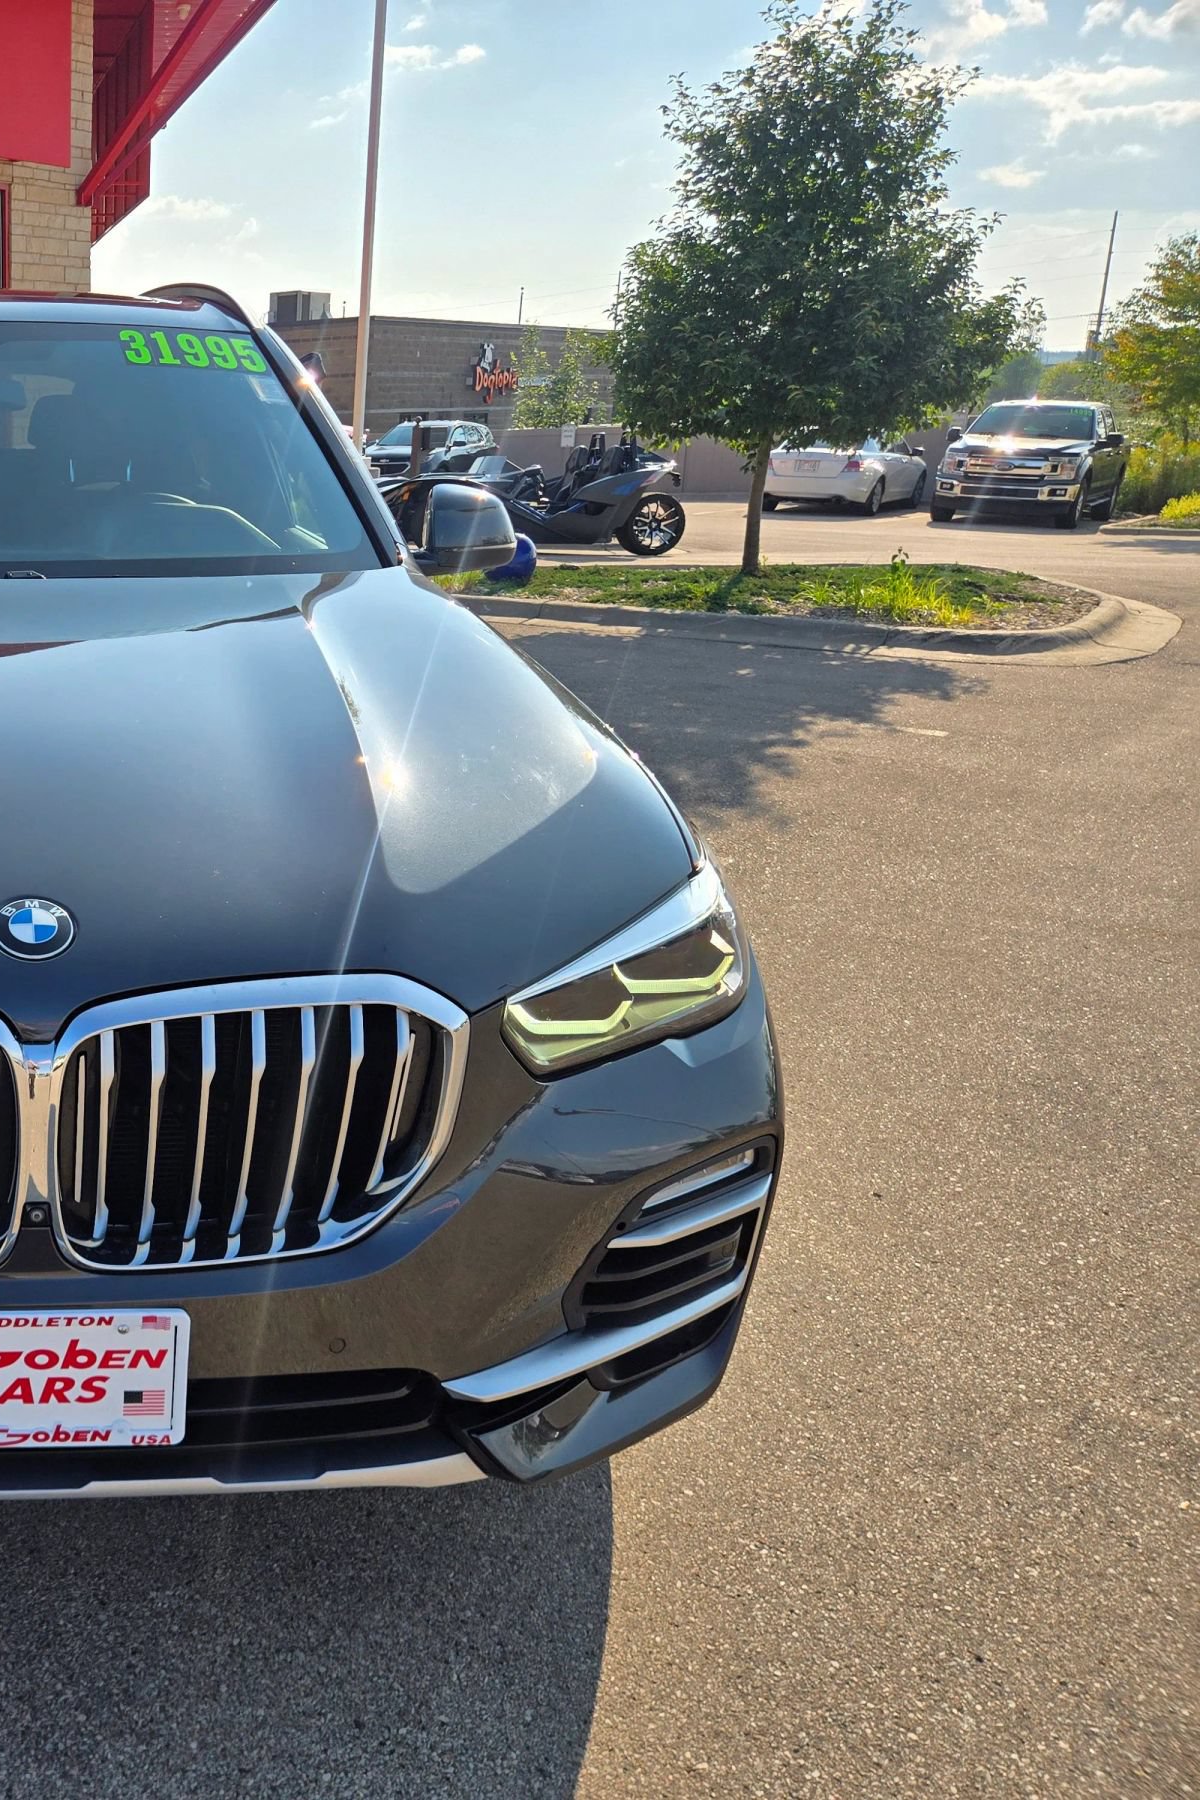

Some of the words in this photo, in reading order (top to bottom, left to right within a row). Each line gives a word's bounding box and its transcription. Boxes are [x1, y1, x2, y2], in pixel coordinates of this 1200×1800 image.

[119, 329, 267, 373] 31995
[1, 900, 67, 917] BMW
[131, 1434, 172, 1447] USA
